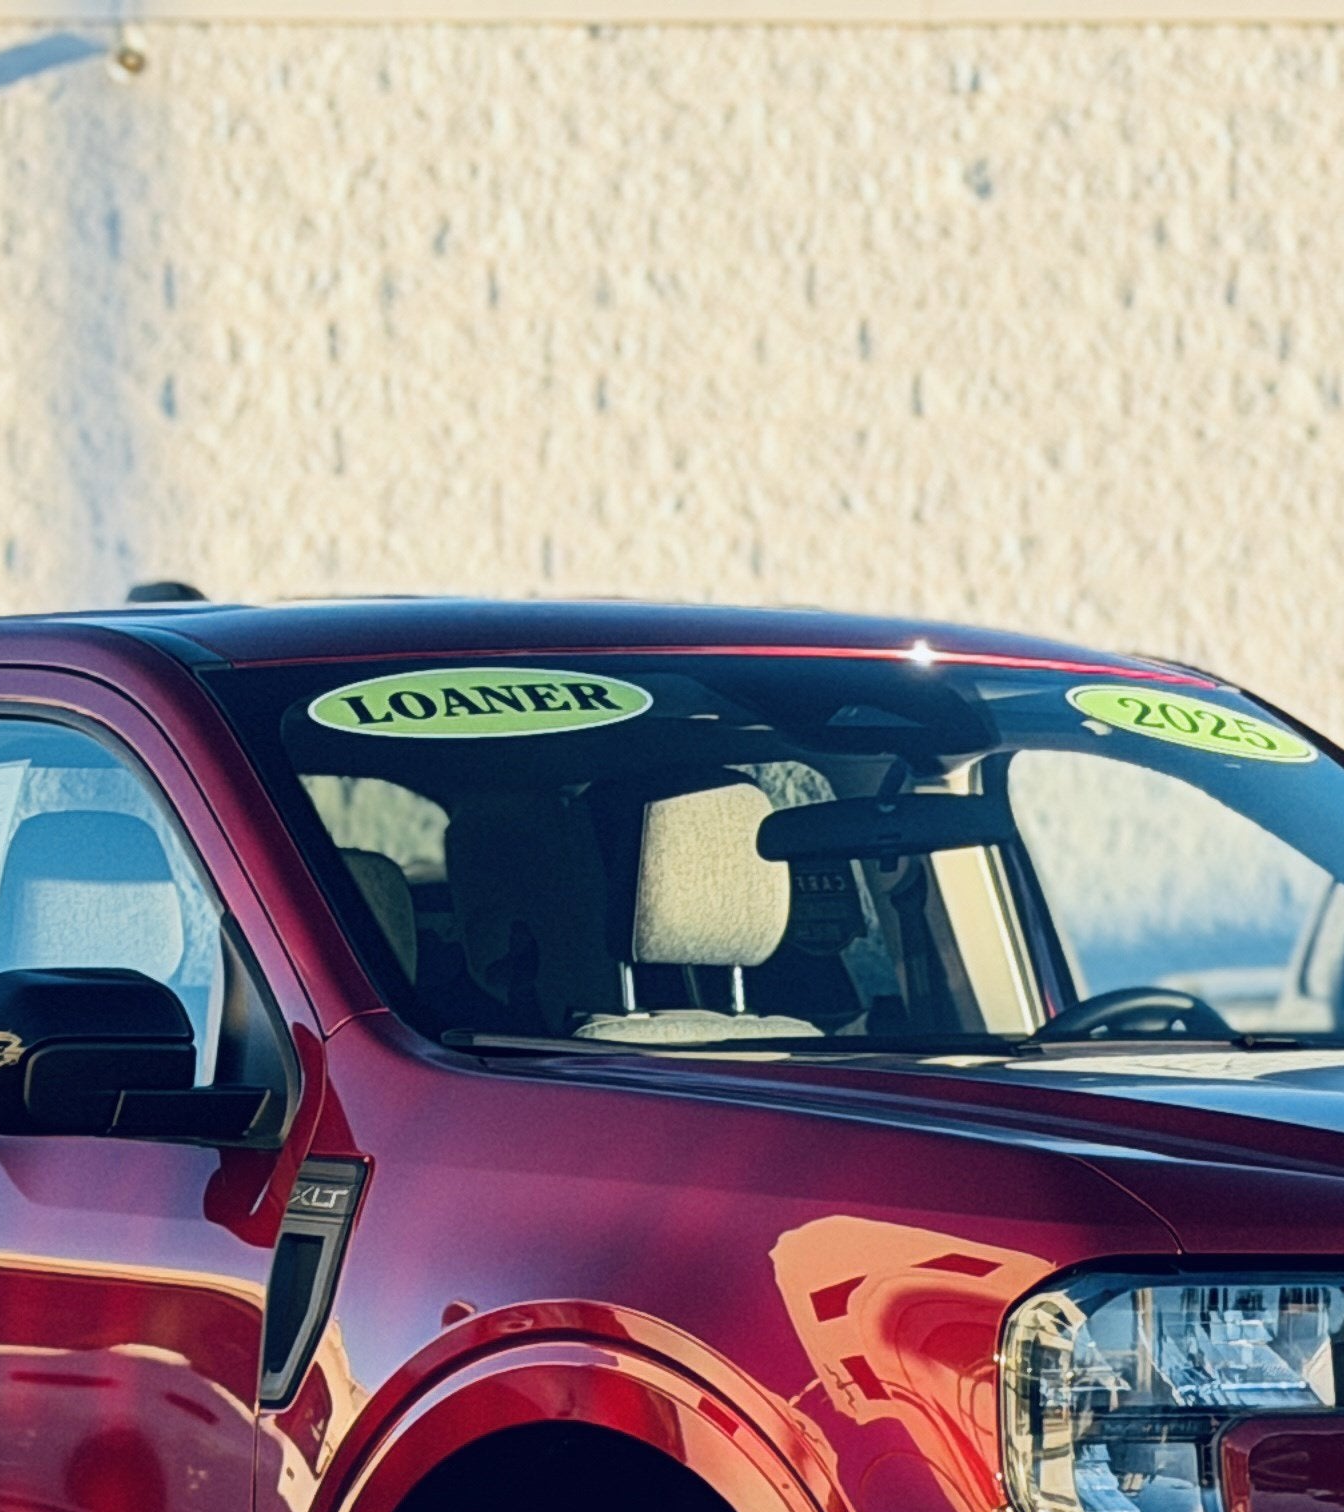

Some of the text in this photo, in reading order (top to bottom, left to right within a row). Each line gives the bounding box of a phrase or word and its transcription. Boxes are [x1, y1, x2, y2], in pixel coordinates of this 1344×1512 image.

[339, 682, 623, 724] LOANER
[1117, 697, 1277, 750] 2025
[289, 1186, 348, 1208] XLT
